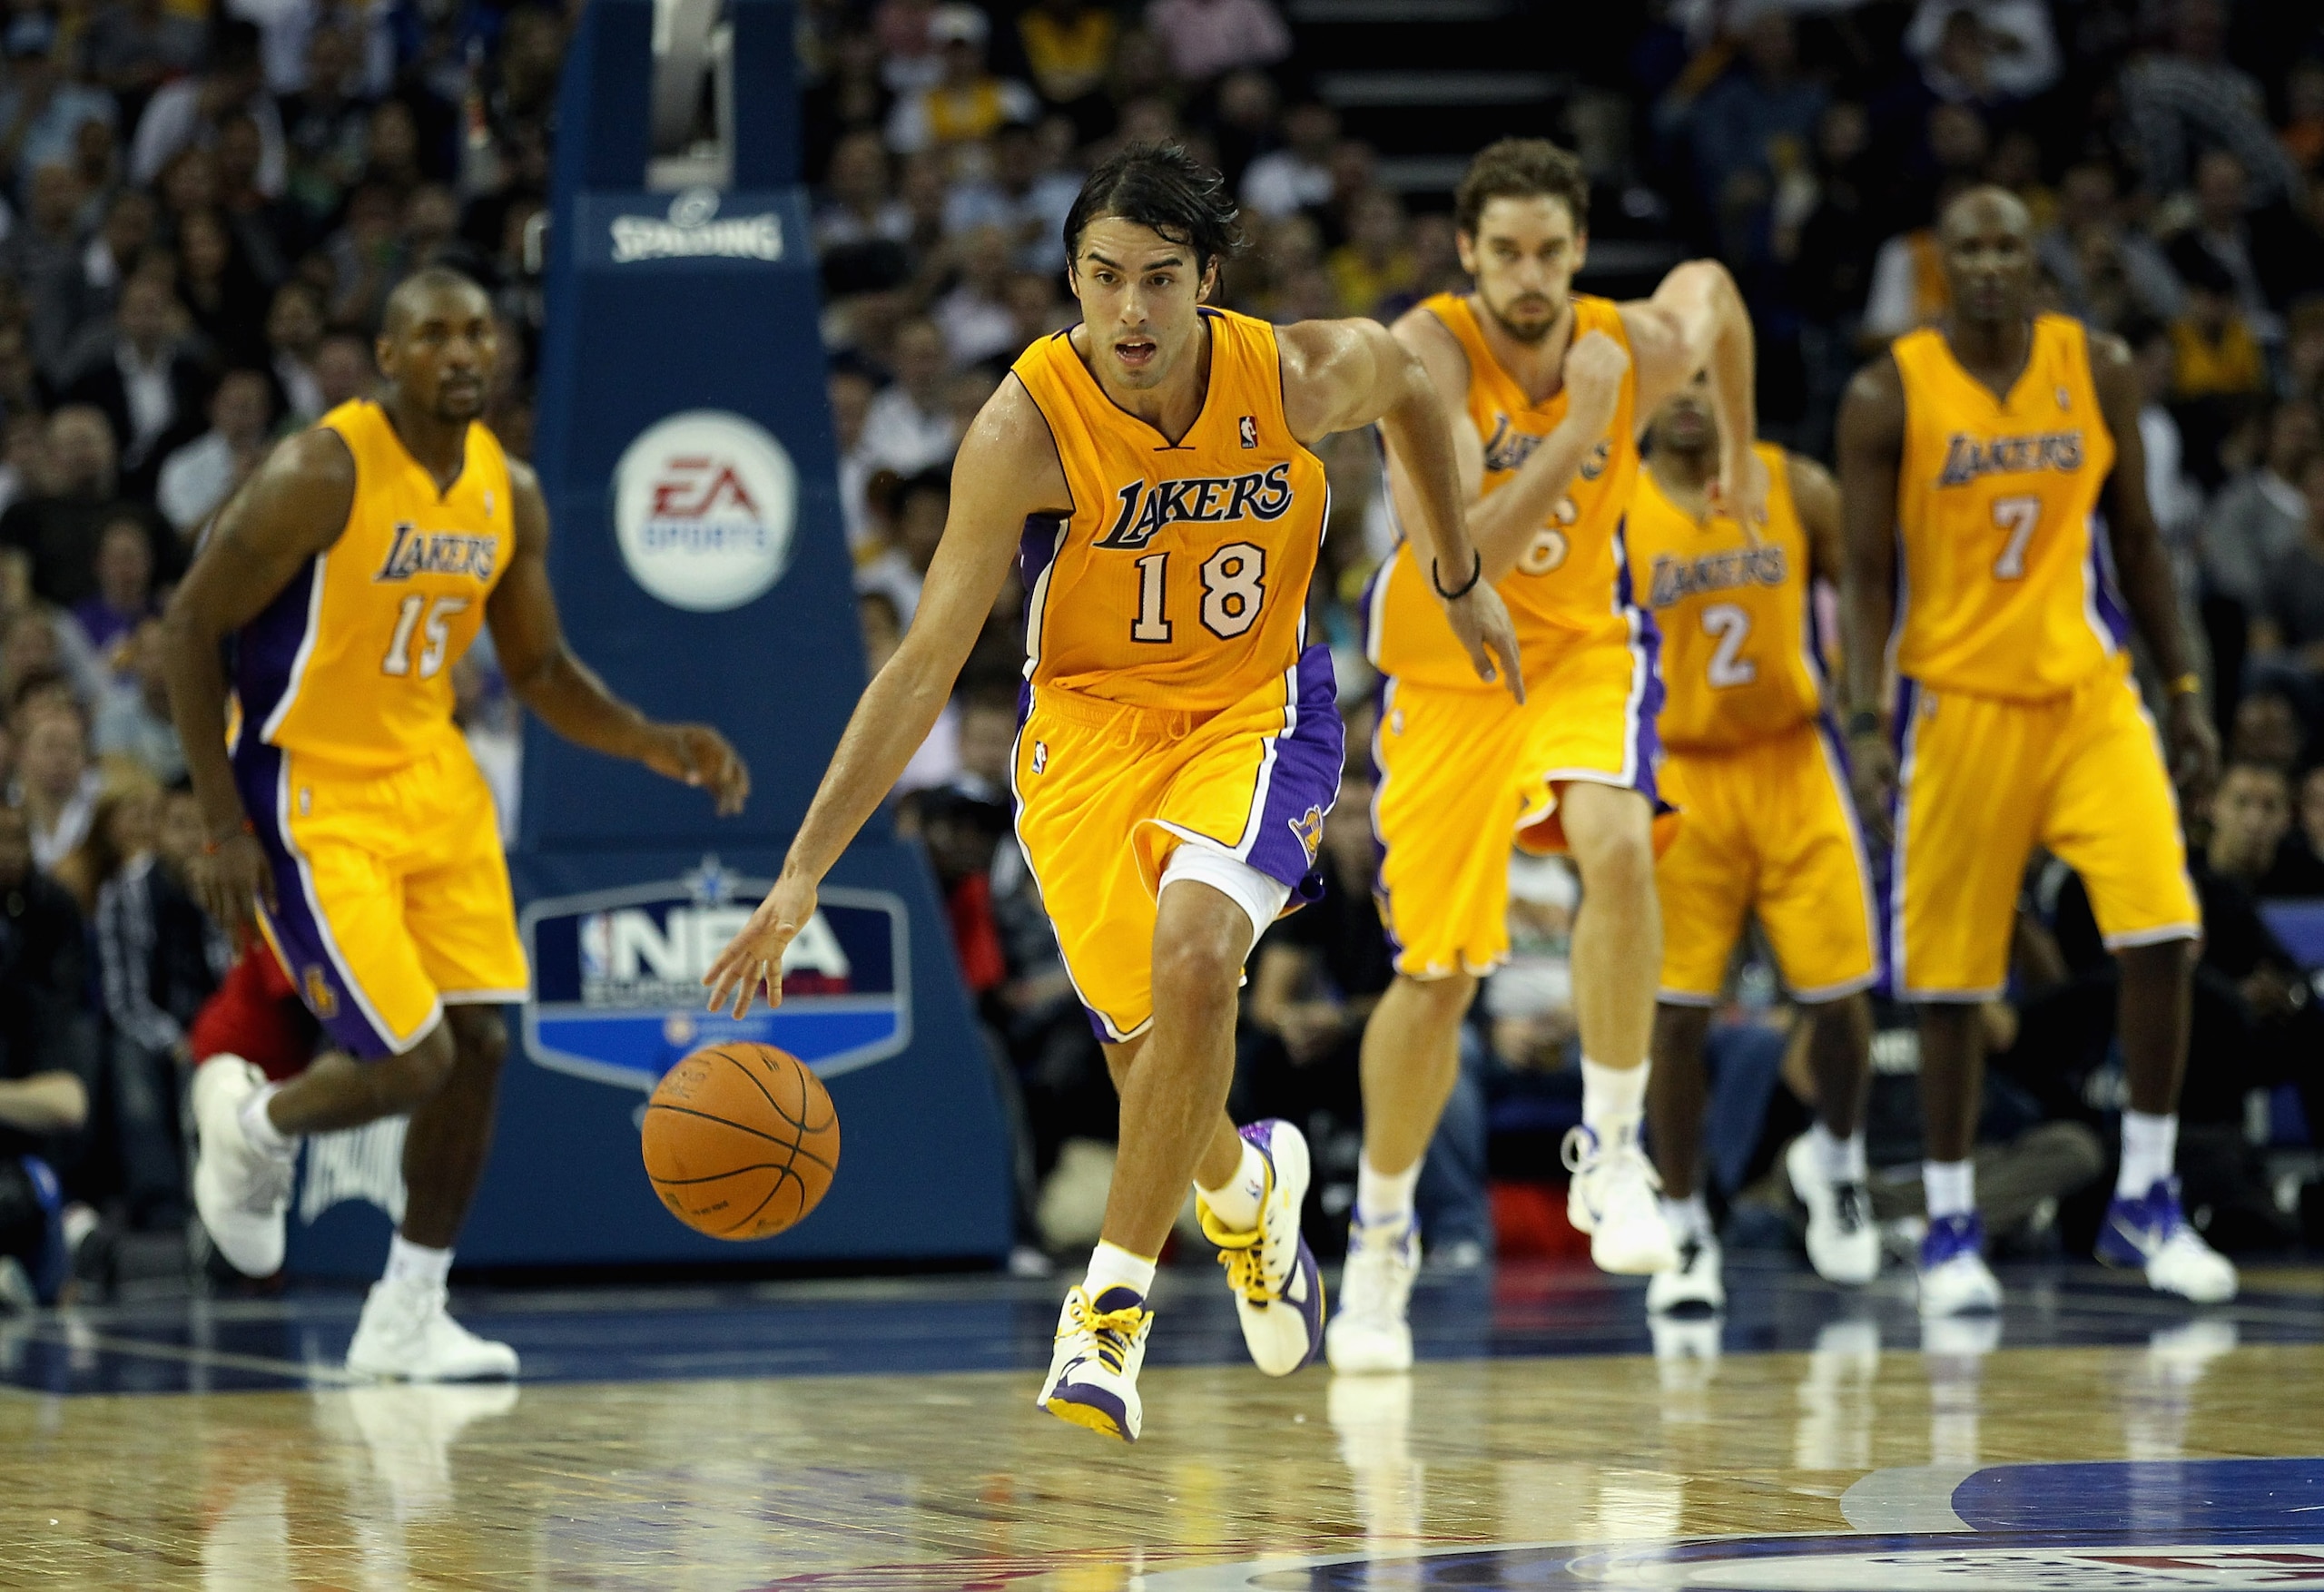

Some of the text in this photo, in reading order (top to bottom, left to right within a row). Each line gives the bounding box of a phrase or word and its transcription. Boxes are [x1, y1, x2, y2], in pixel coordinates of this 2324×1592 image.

[610, 211, 784, 262] SPALDING
[652, 456, 761, 519] EA
[1934, 430, 2084, 489] LAKERS
[644, 523, 766, 552] SPORTS
[1090, 461, 1294, 550] LAKERS
[1992, 496, 2040, 580] 7
[371, 519, 499, 584] LAKERS
[1650, 547, 1788, 607] LAKERS
[1130, 540, 1267, 644] 18
[380, 593, 472, 679] 15
[1701, 604, 1758, 688] 2
